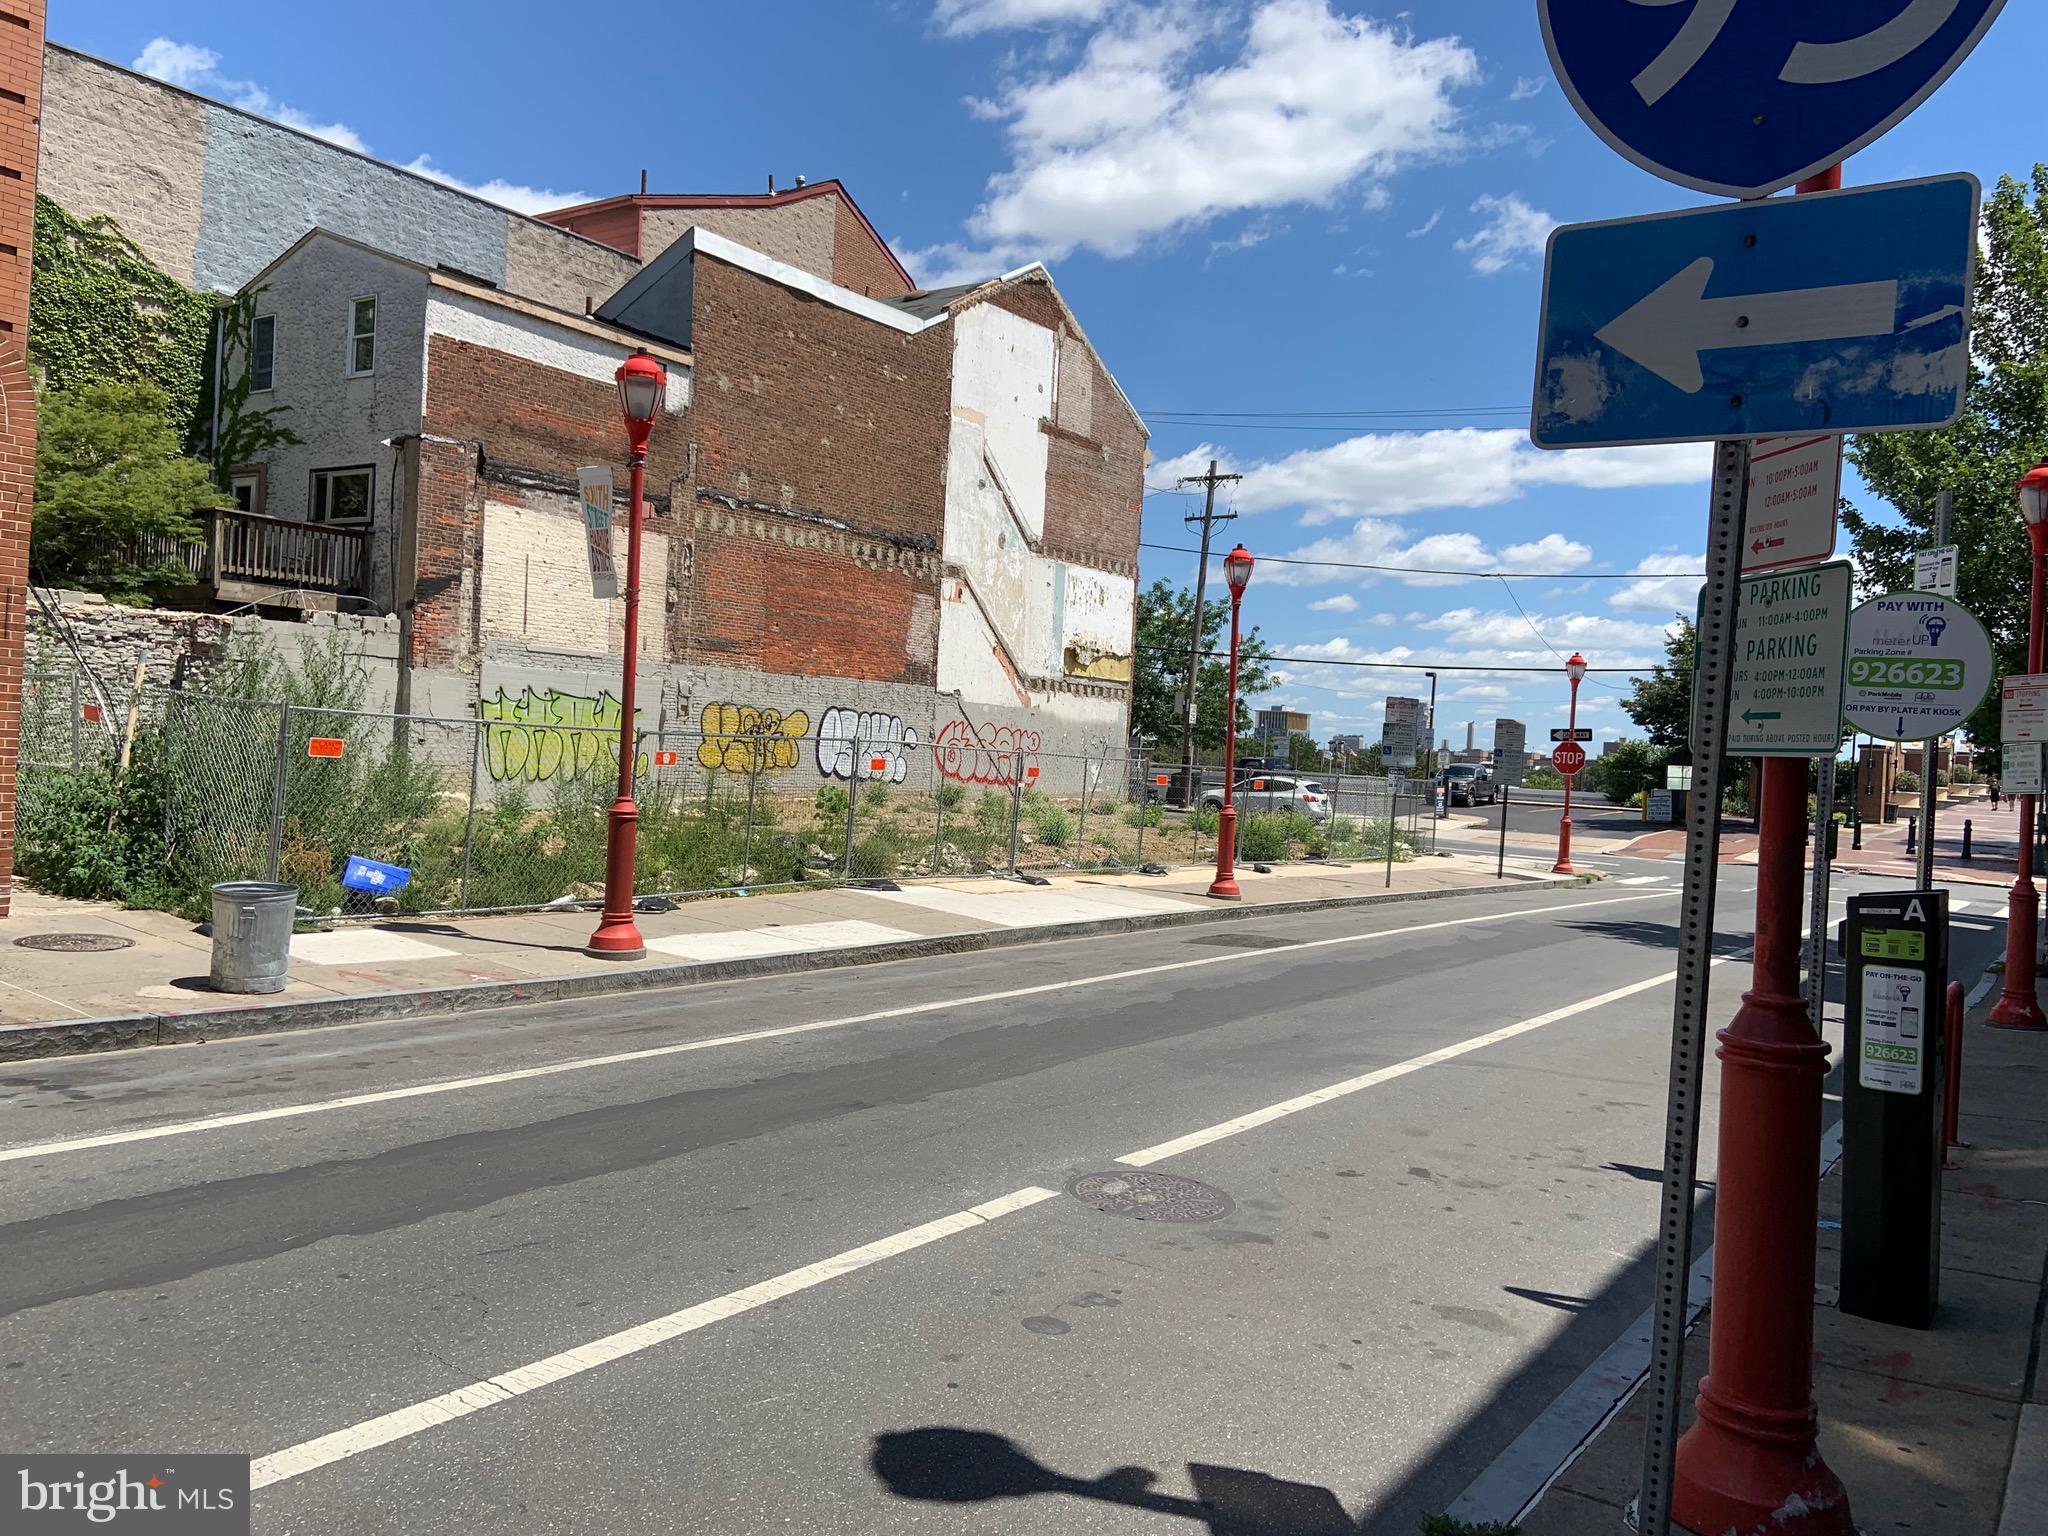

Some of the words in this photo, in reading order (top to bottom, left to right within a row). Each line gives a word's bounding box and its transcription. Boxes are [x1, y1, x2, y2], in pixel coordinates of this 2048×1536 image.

[1764, 484, 1818, 508] 12:00AM-5:00AM
[1750, 573, 1821, 605] PARKING
[1877, 601, 1903, 612] PAY
[1907, 601, 1945, 612] WITH
[1758, 607, 1828, 627] 11:00AM-4:00PM
[1746, 633, 1817, 661] PARKING
[1854, 647, 1884, 656] Parking
[1885, 648, 1906, 656] Zone
[1754, 666, 1825, 682] 4:00PM-12:00AM
[1851, 661, 1961, 686] 926623
[1753, 685, 1824, 700] 4:00PM-10:00PM
[1845, 704, 1858, 712] OR
[1859, 704, 1877, 712] PAY
[1877, 705, 1890, 713] BY
[1891, 706, 1918, 715] PLATE
[1919, 707, 1931, 715] AT
[1932, 708, 1961, 717] KIOSK
[1788, 734, 1811, 743] POSTED
[1813, 734, 1835, 743] HOURS
[1554, 751, 1584, 764] STOP
[1903, 898, 1926, 922] A
[1865, 970, 1879, 978] PAY
[1880, 972, 1922, 982] ON-THE-GO
[1866, 1045, 1916, 1062] 926623
